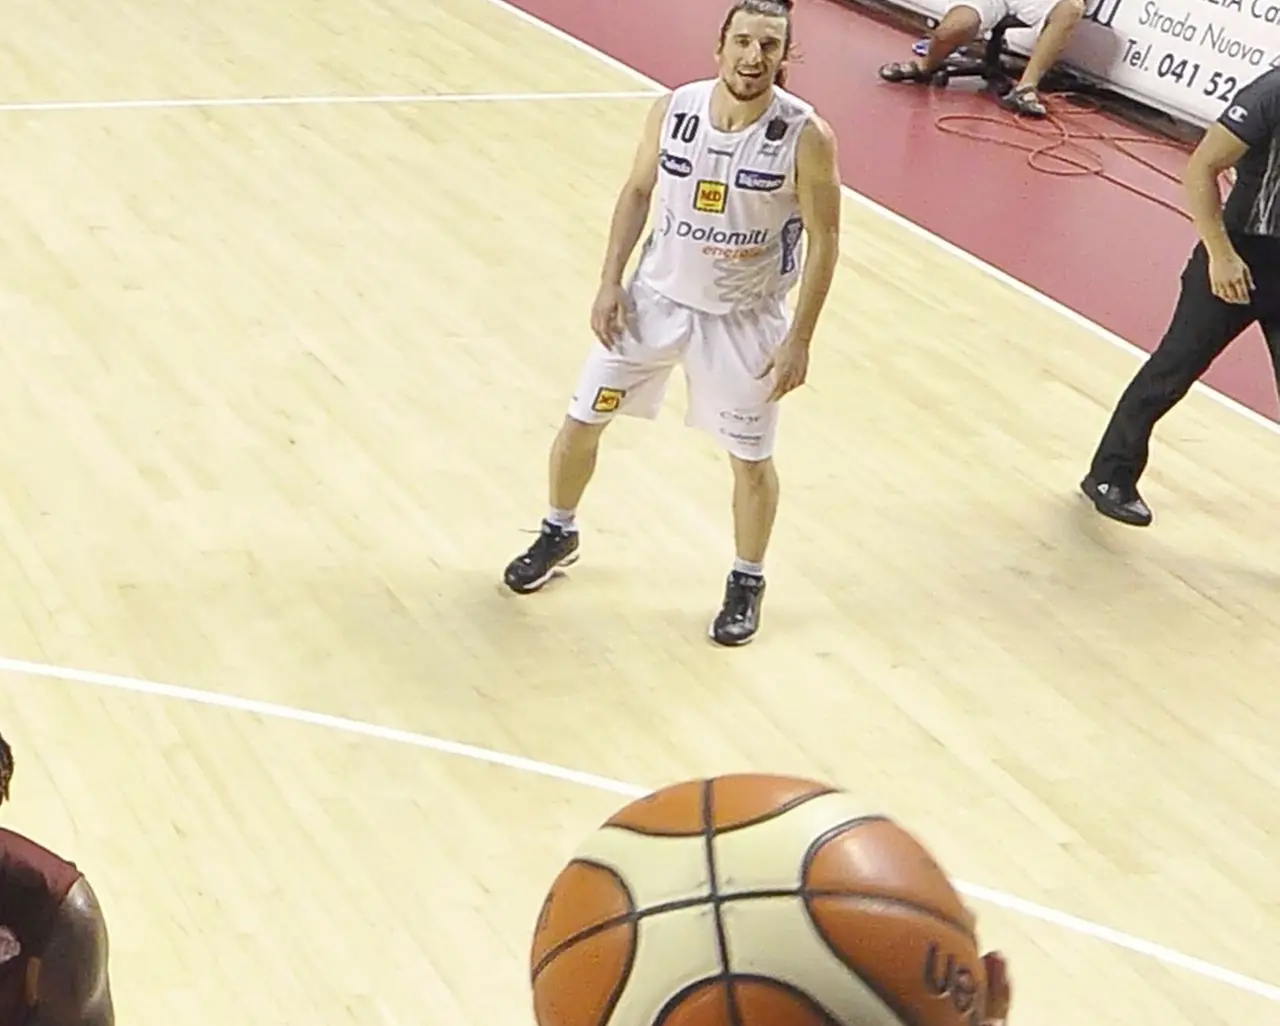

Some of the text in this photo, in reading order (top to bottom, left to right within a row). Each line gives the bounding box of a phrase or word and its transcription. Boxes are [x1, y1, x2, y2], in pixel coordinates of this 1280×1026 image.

[1251, 0, 1280, 26] Ca
[1138, 0, 1197, 42] Strada
[1200, 22, 1265, 66] Nuova
[1122, 38, 1238, 103] Tel. 041 52
[671, 112, 700, 143] 10
[676, 220, 770, 246] Dolomiti
